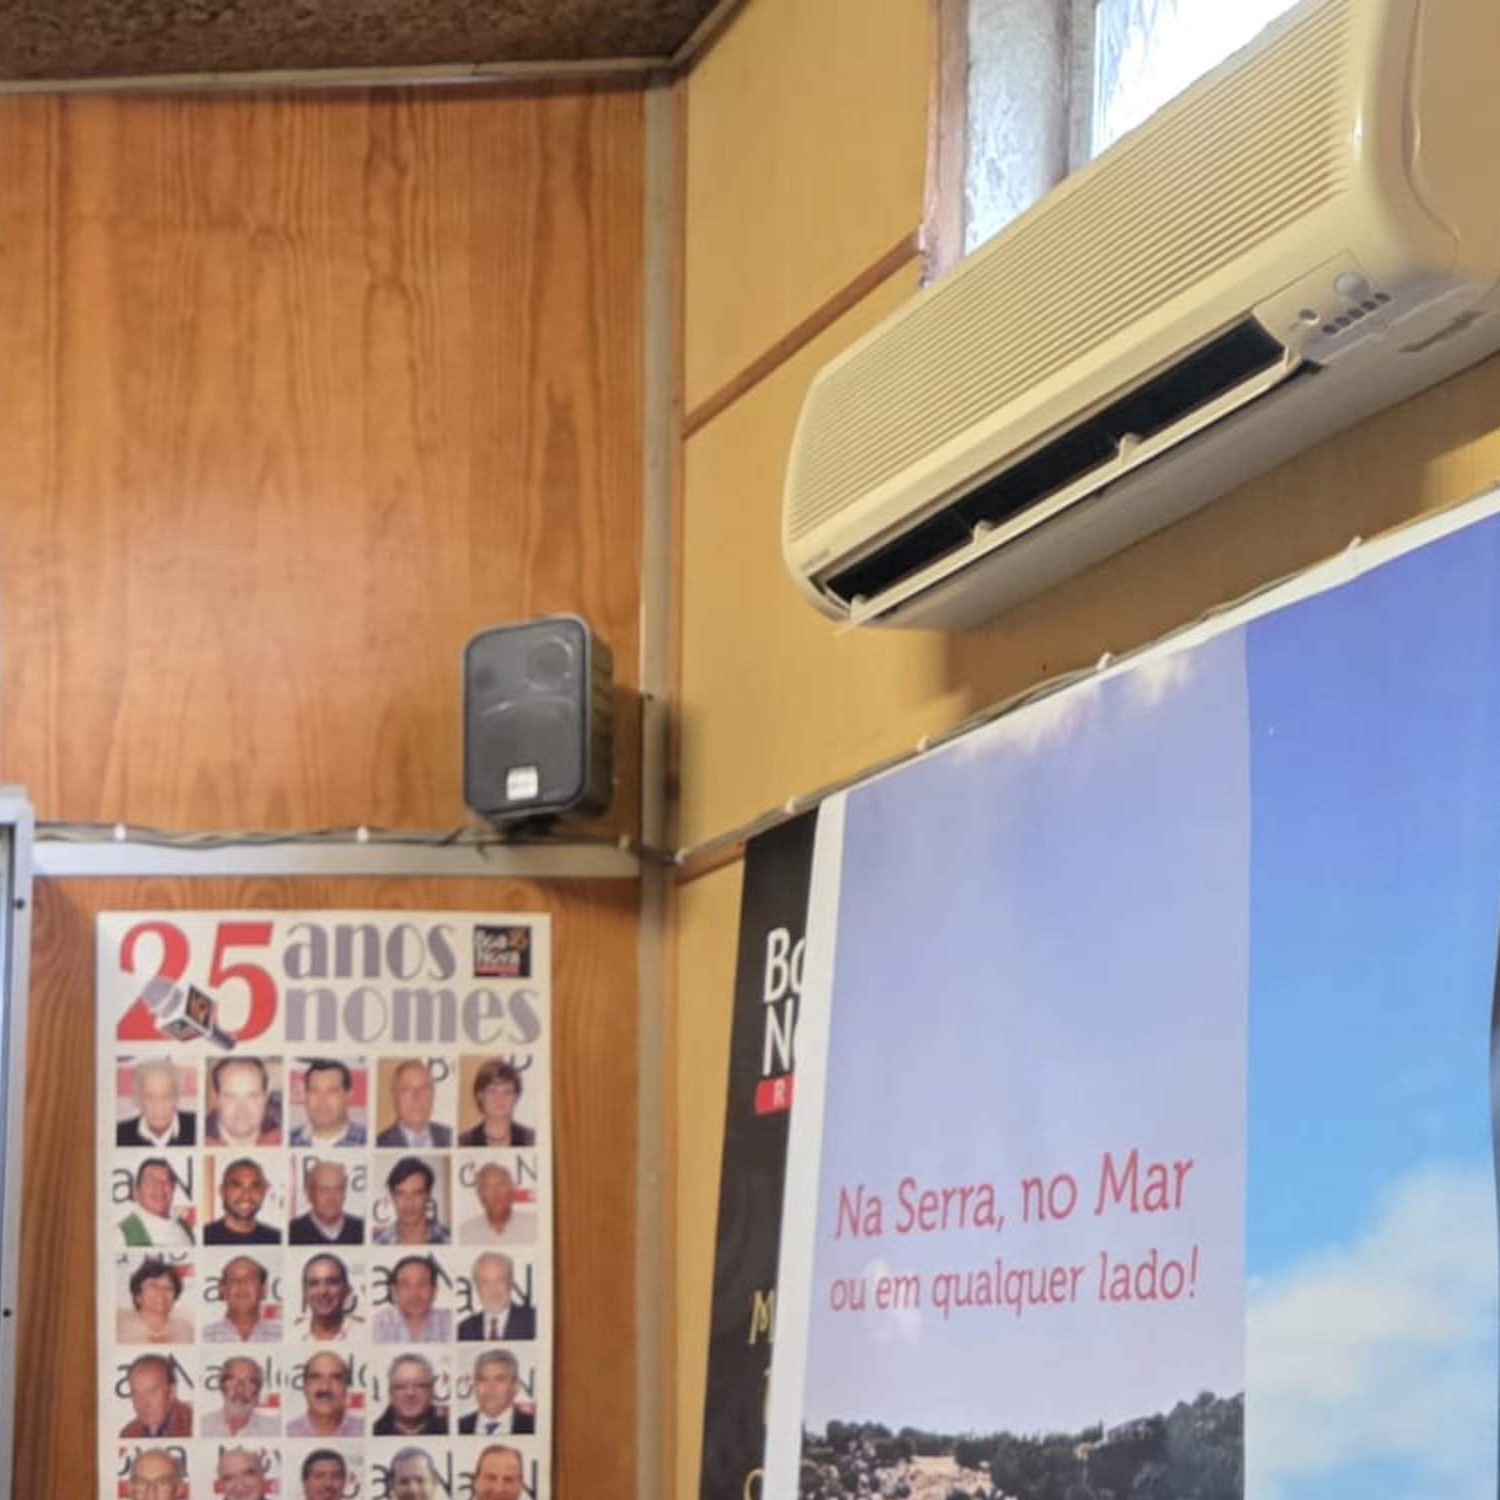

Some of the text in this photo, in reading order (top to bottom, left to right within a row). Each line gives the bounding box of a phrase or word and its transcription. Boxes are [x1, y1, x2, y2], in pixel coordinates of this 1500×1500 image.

[116, 921, 457, 1043] 25 anos
[284, 986, 542, 1045] nomes
[835, 1149, 1194, 1239] Na Serra, no Mar
[831, 1245, 1198, 1320] ou em qualquer lado!
